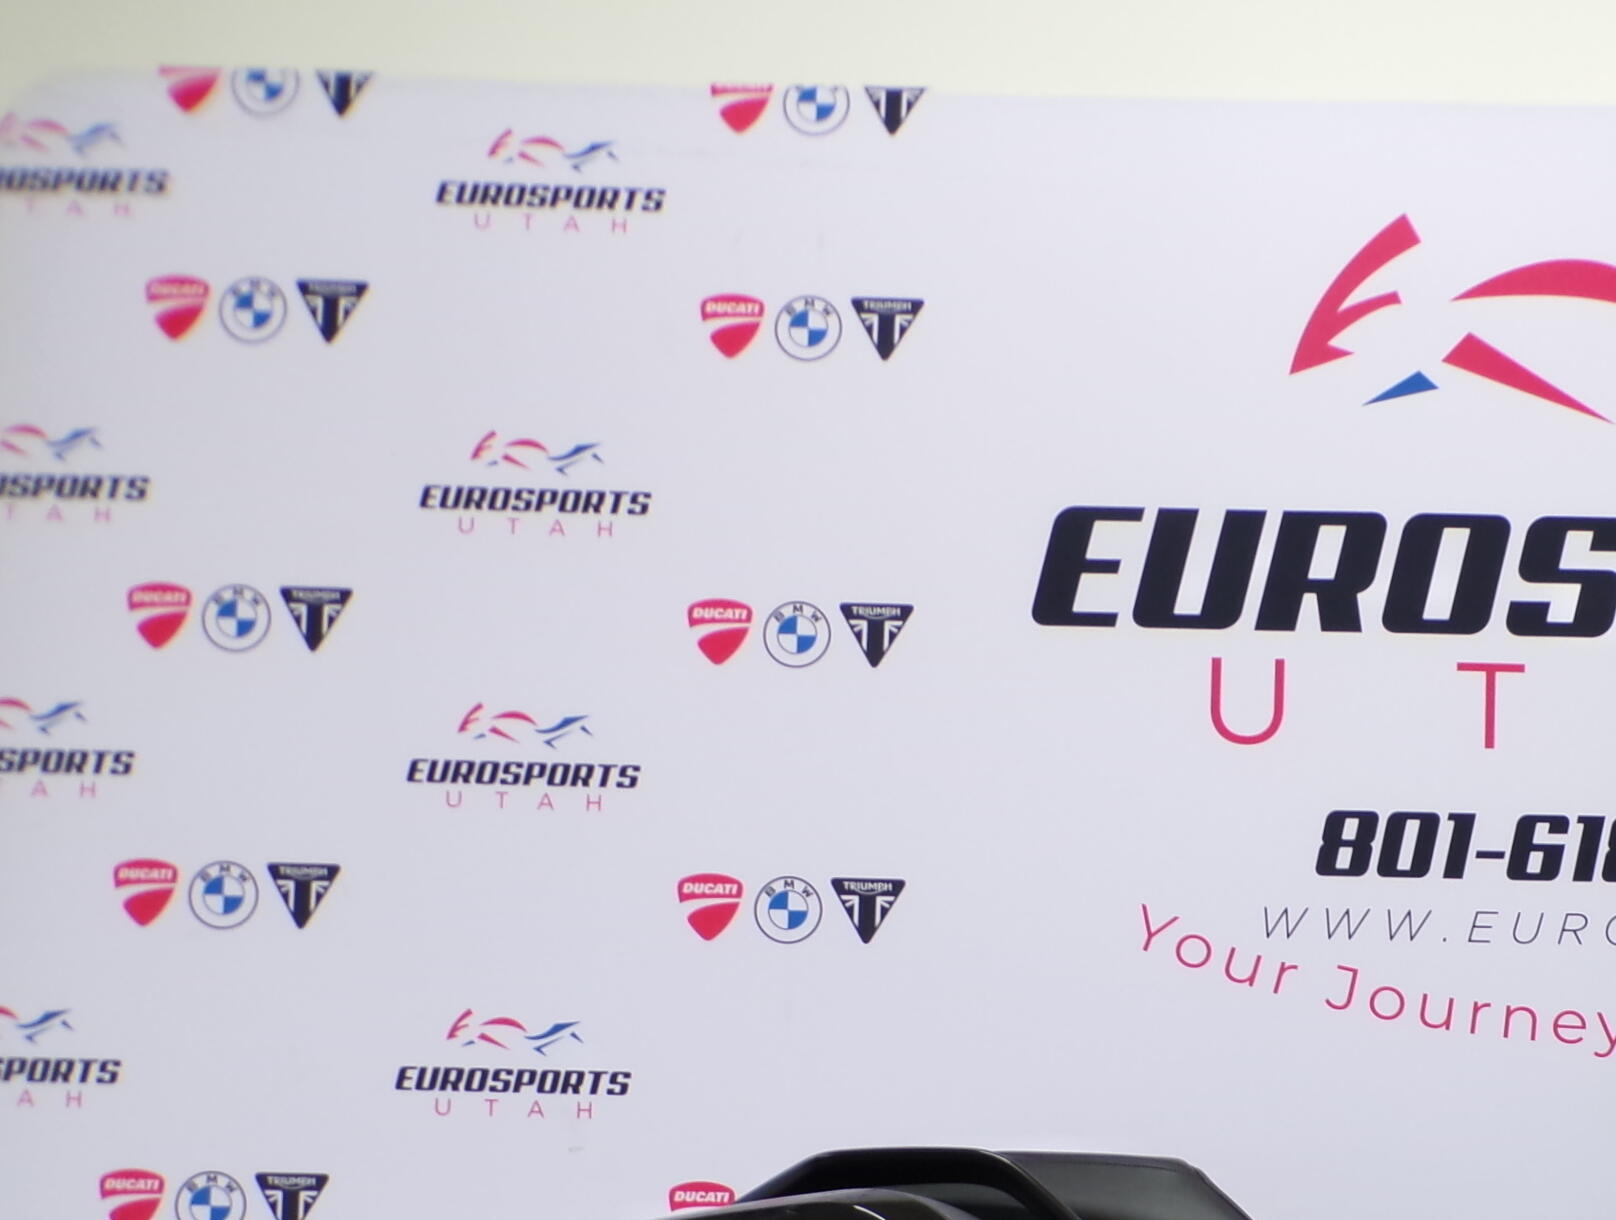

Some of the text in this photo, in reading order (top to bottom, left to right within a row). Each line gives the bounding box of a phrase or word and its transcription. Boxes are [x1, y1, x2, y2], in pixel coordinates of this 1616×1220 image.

[0, 167, 170, 195] OSPORTS
[435, 179, 667, 213] EUROSPORTS
[473, 213, 628, 235] UTAH
[419, 484, 653, 516] EUROSPORTS
[457, 517, 614, 538] UTAH
[692, 607, 748, 620] DUCATI
[406, 758, 642, 789] EUROSPORTS
[445, 790, 603, 812] UTAH
[682, 881, 738, 895] DUCATI
[1137, 903, 1299, 995] Your
[0, 1057, 123, 1085] PORTS
[394, 1066, 633, 1096] EUROSPORTS
[434, 1098, 593, 1120] UTAH
[104, 1178, 160, 1191] DUCATI
[674, 1191, 730, 1203] DUCATI
